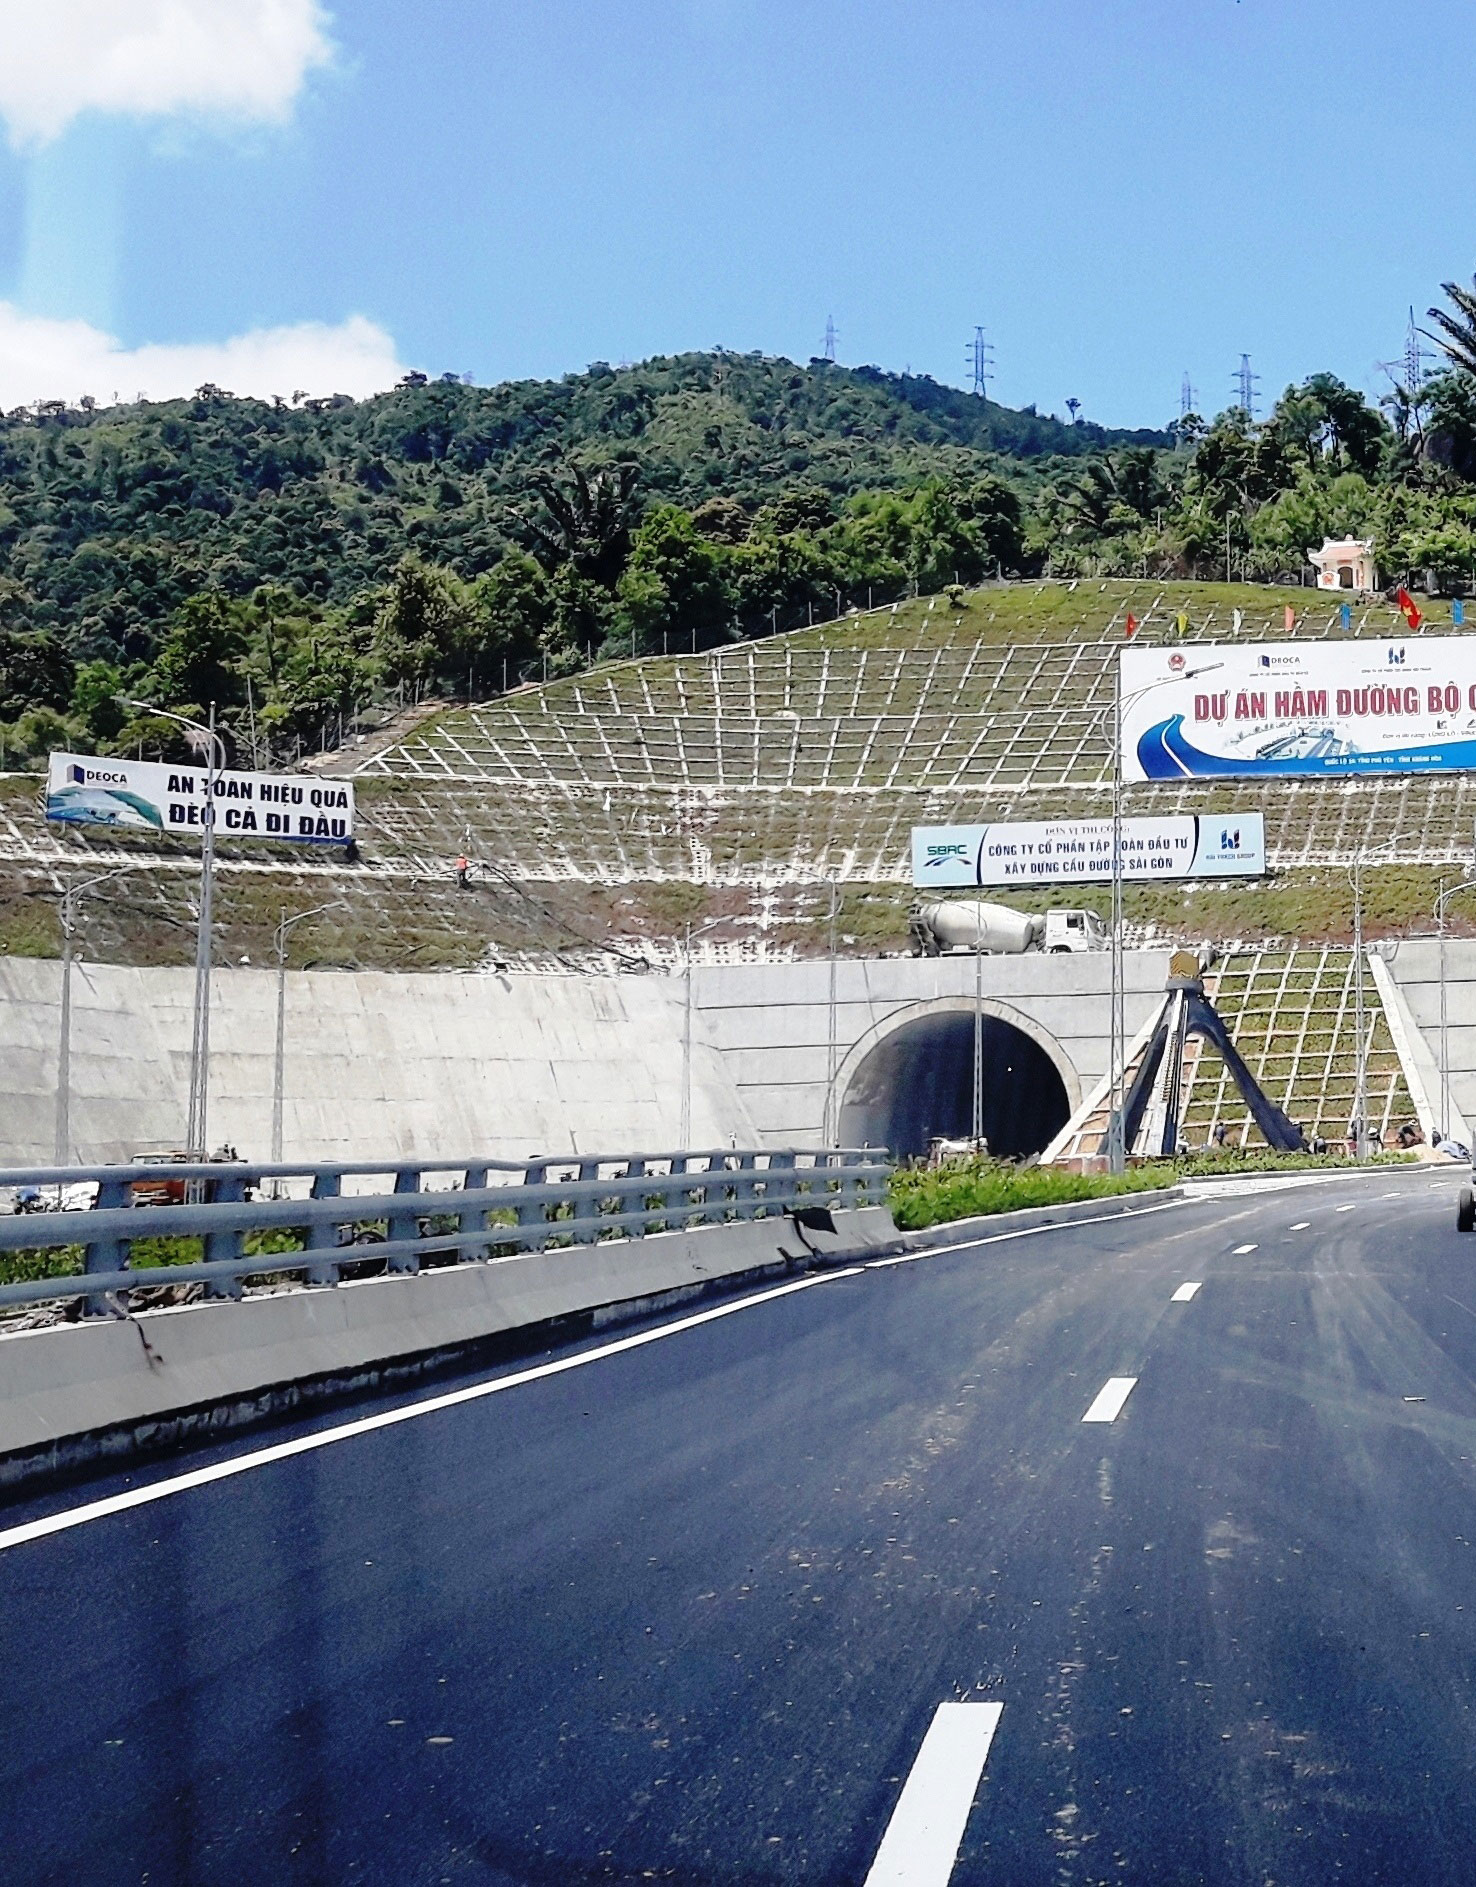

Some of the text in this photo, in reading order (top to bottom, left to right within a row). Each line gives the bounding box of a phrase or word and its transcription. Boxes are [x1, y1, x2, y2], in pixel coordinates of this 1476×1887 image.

[1194, 690, 1229, 726] DỰ
[1234, 688, 1266, 720] ÁN
[1275, 681, 1328, 718] HẦM
[1336, 684, 1419, 717] ĐƯỜNG
[1427, 681, 1460, 718] BỘ
[87, 770, 127, 784] DEOCA
[168, 775, 194, 794] AN
[261, 783, 303, 807] HIỆU
[310, 787, 348, 809] QUẢ
[225, 806, 257, 831] CẢ
[265, 813, 290, 833] ĐI
[299, 811, 346, 837] ĐẦU
[988, 842, 1017, 857] CÔNG
[1021, 843, 1034, 856] TY
[1090, 838, 1110, 855] TẬP
[1175, 836, 1189, 849] TƯ
[1004, 861, 1026, 875] XÂY
[1031, 860, 1059, 877] DỰNG
[1129, 856, 1147, 870] SÀI
[1151, 856, 1173, 870] GÒN
